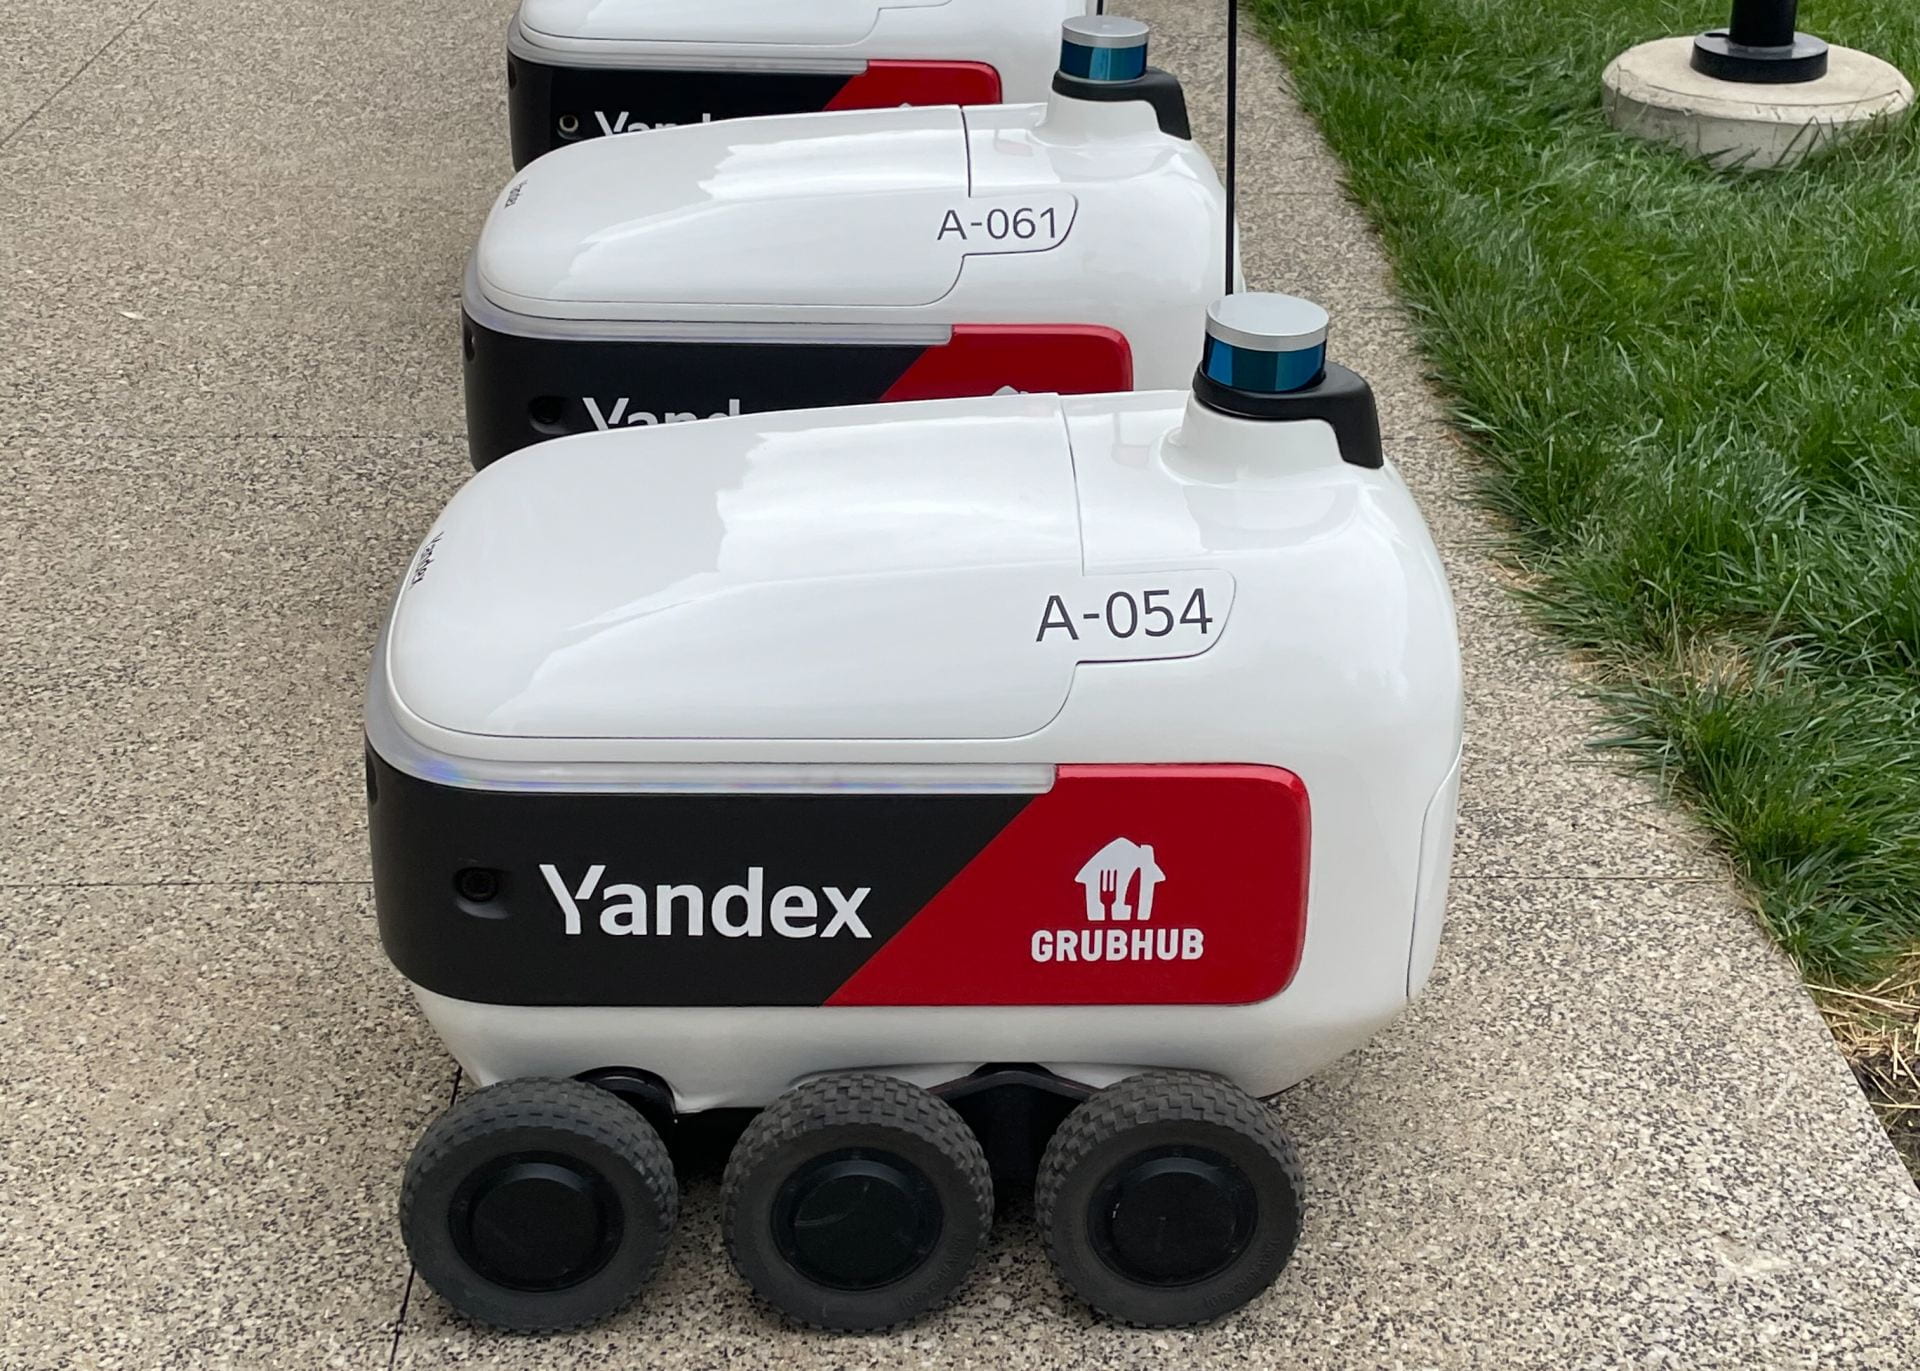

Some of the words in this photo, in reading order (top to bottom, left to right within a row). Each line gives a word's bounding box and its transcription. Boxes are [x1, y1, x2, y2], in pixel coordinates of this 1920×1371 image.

[937, 207, 1056, 241] A-061
[1036, 588, 1214, 642] A-054
[539, 864, 872, 940] Yandex
[1031, 929, 1205, 963] GRUBHUB
